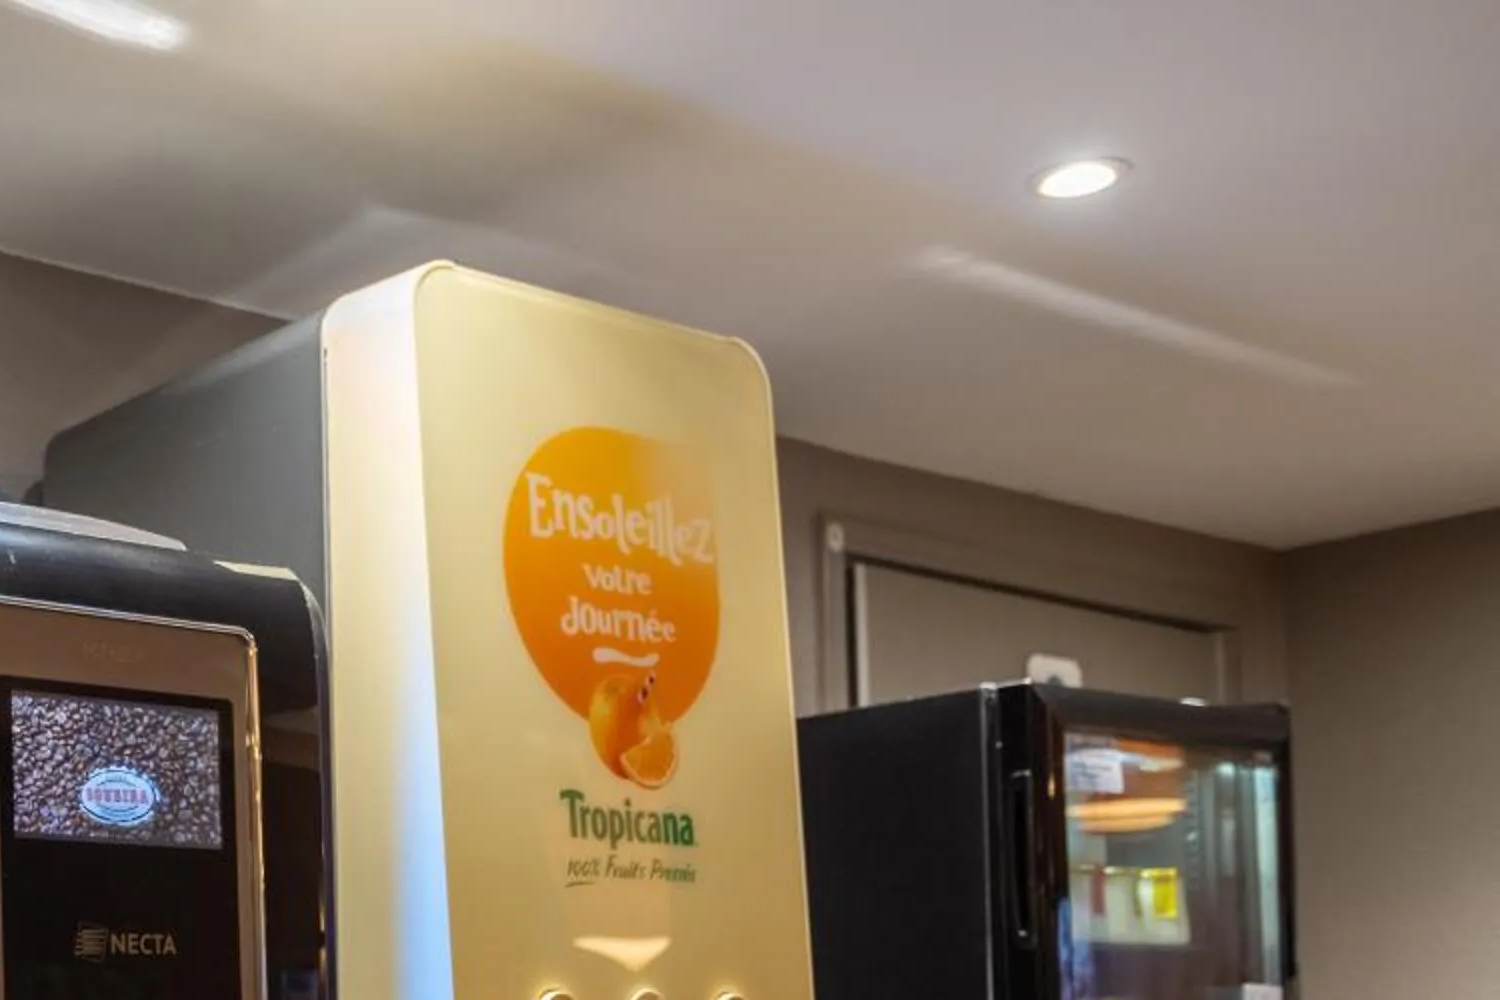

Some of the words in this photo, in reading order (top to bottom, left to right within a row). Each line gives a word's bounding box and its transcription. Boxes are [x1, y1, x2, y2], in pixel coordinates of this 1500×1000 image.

[560, 788, 695, 850] Tropicana
[605, 854, 647, 879] Fruits
[110, 932, 178, 957] NECTA
